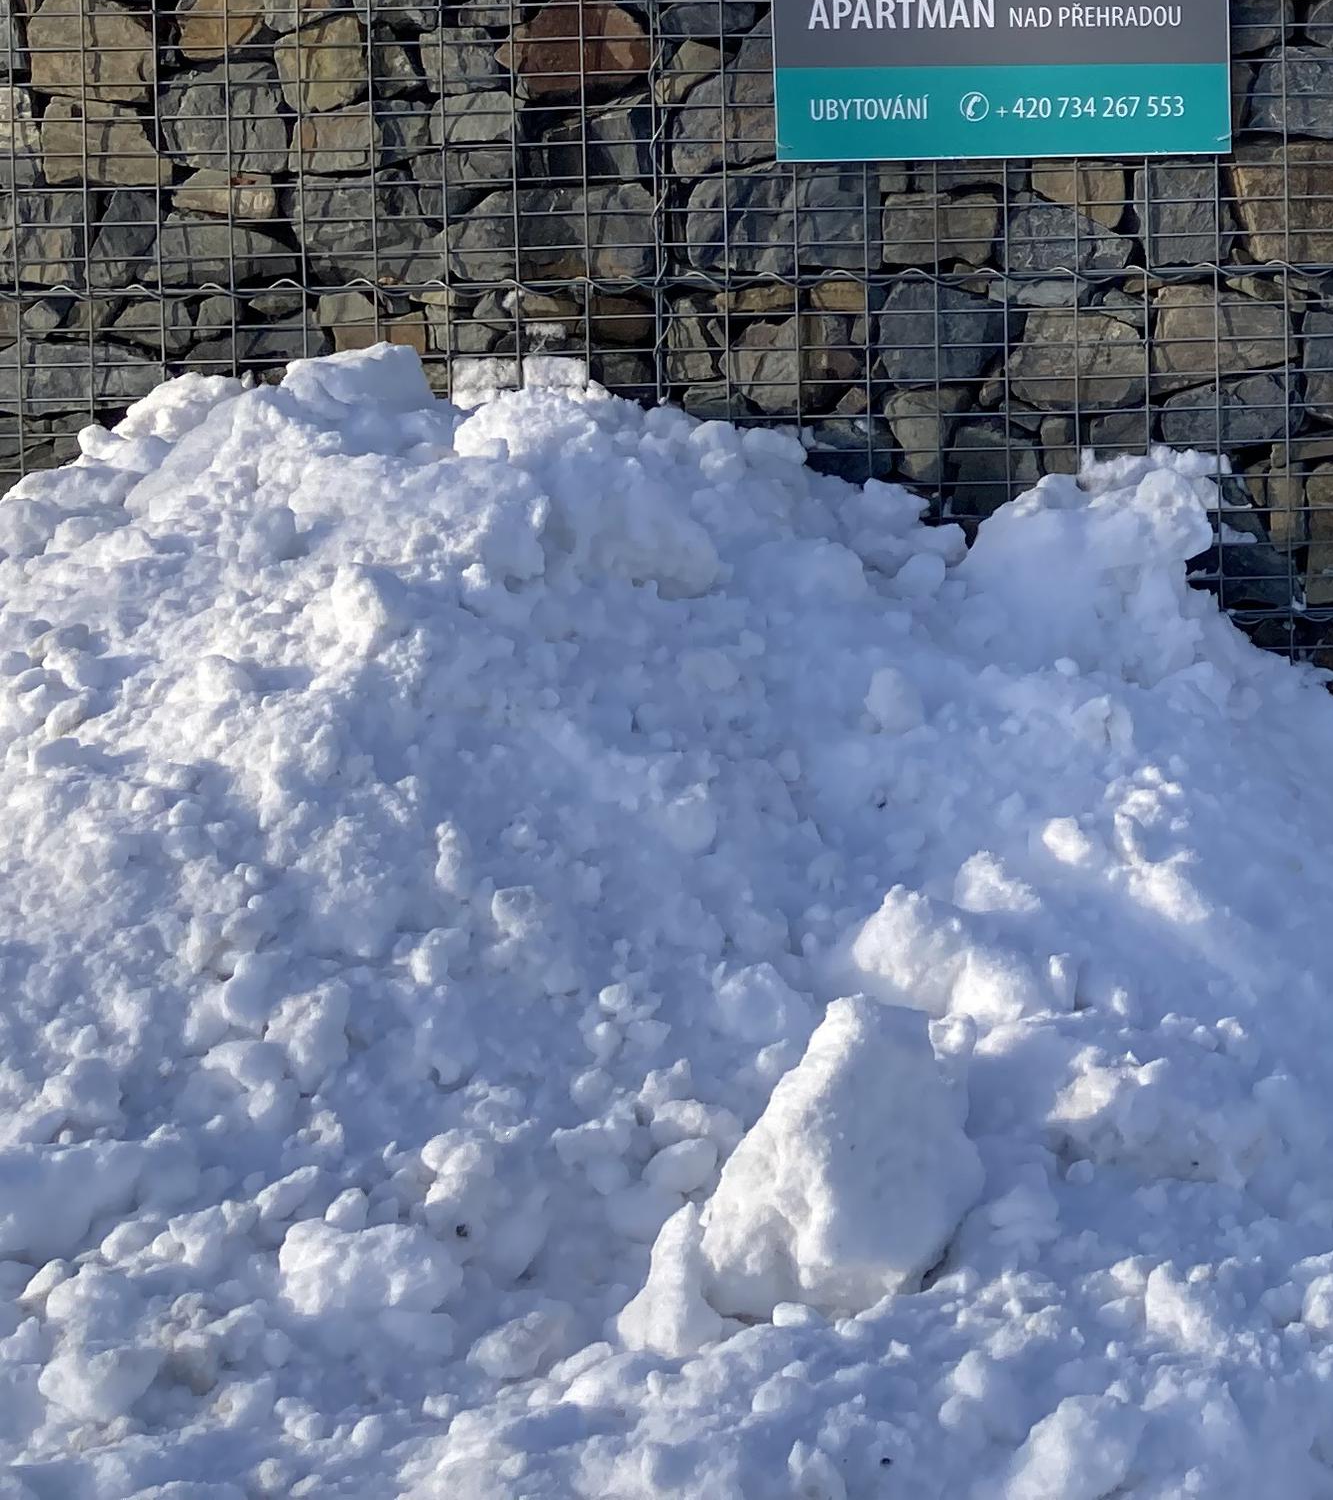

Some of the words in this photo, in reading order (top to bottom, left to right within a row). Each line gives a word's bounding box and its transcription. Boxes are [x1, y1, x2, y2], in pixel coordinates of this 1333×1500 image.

[1009, 6, 1053, 28] NAD
[1058, 2, 1182, 28] PŘEHRADOU
[810, 93, 929, 121] UBYTOVÁNÍ
[1057, 96, 1097, 118] 734
[1102, 96, 1141, 118] 267
[1146, 95, 1185, 117] 553
